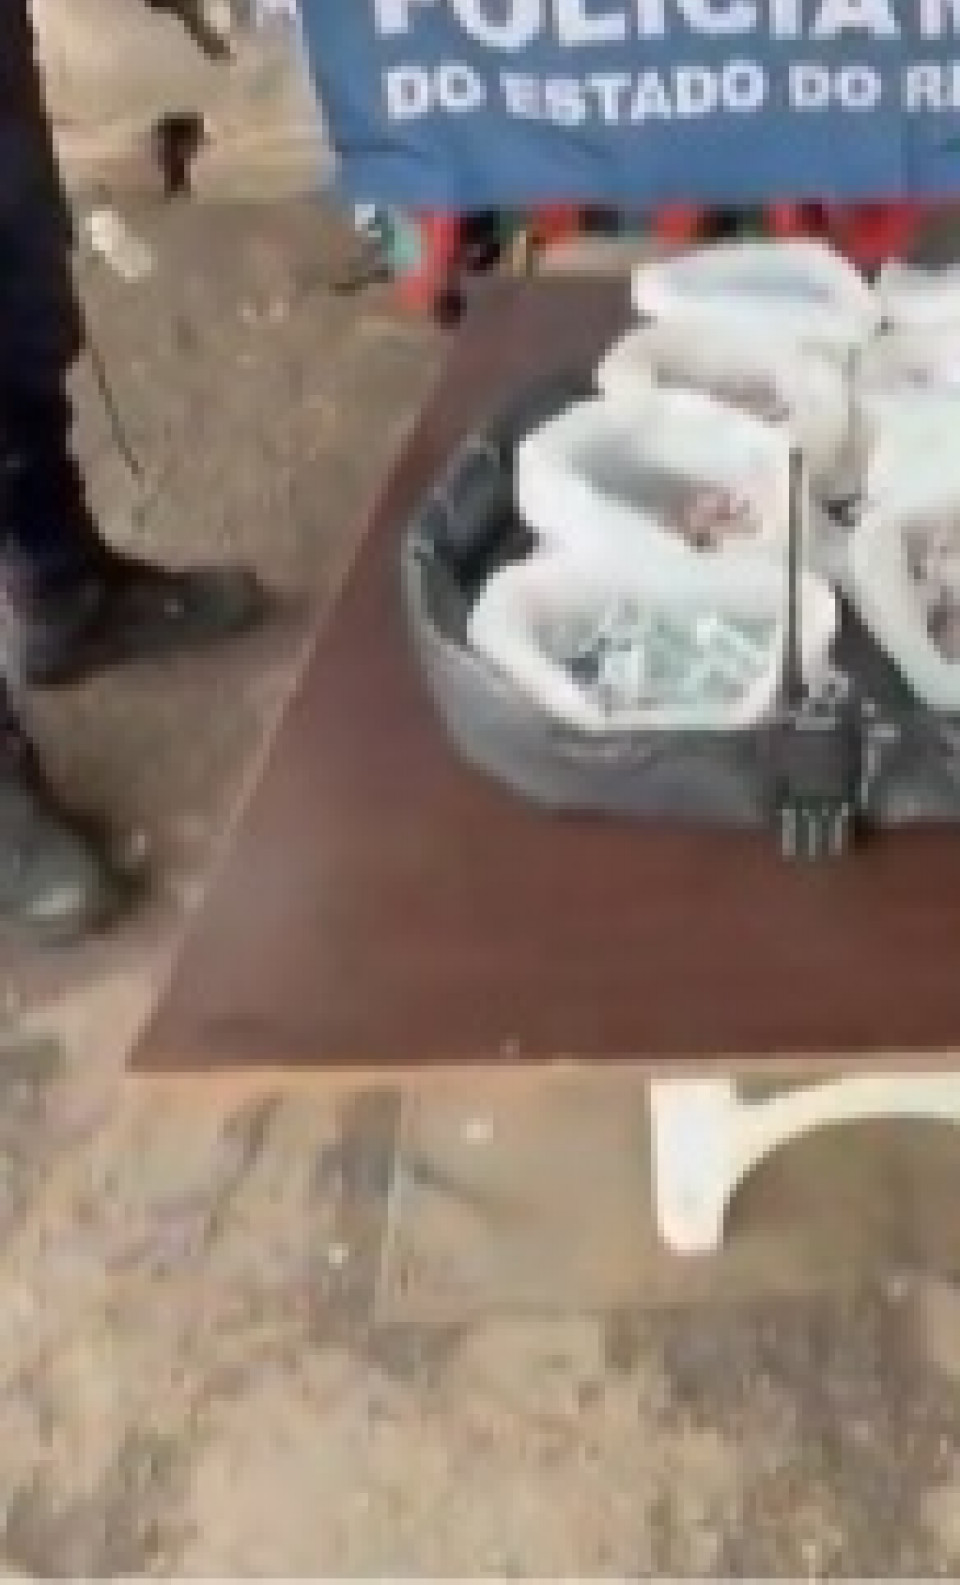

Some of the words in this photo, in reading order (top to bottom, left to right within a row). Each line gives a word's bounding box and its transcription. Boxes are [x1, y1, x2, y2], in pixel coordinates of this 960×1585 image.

[386, 60, 486, 120] DO
[501, 61, 768, 125] ESTADO
[788, 65, 881, 113] DO
